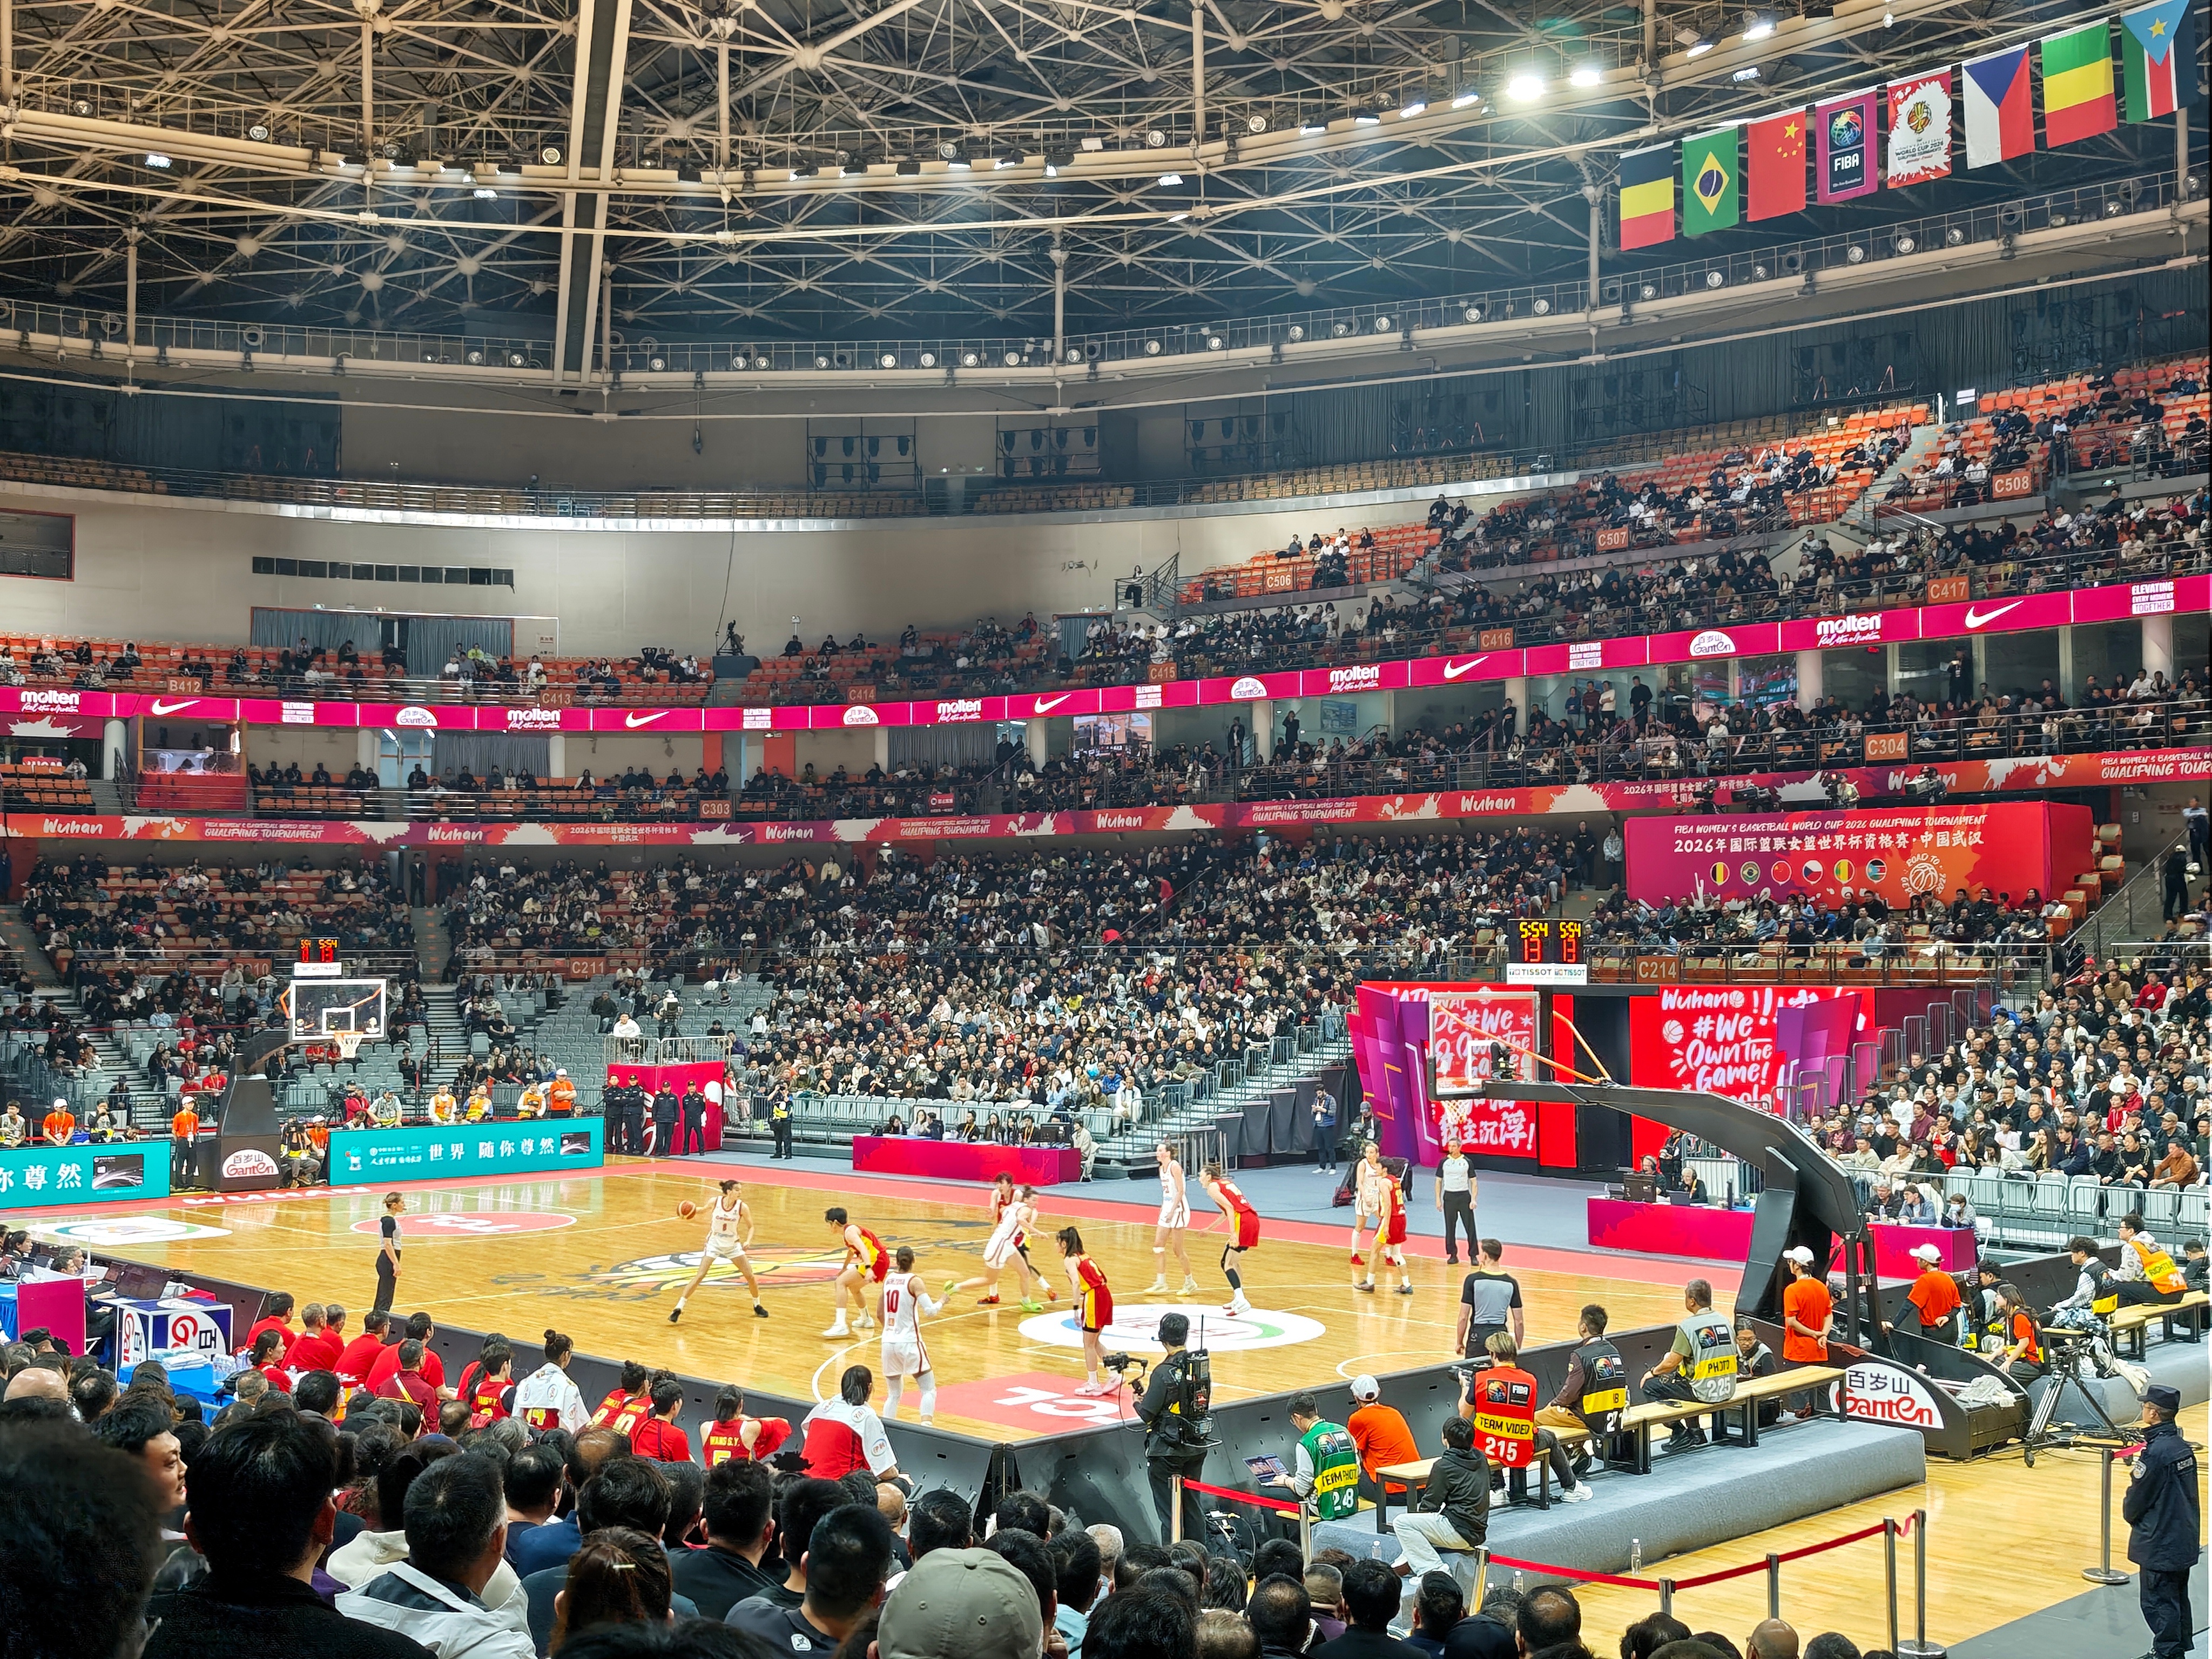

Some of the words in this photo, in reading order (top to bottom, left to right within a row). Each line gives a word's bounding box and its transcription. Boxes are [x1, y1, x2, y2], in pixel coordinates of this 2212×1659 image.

[1834, 153, 1859, 172] FIBA
[1994, 472, 2029, 494] C508
[1598, 531, 1627, 548] C507
[1266, 573, 1291, 589] C506
[2132, 581, 2174, 596] ELEVATING
[1930, 581, 1966, 601] C417
[2135, 601, 2172, 613] TOGETHER
[1816, 615, 1881, 636] molten
[1481, 632, 1511, 648] C416
[1150, 666, 1176, 680] C415
[1330, 665, 1380, 683] molten
[169, 679, 201, 693] B412
[21, 690, 80, 705] molten
[542, 692, 572, 705] C413
[848, 689, 875, 702] C414
[507, 709, 561, 721] molten
[937, 698, 982, 714] molten
[1868, 737, 1905, 756] C304
[2101, 763, 2174, 779] QUALIFYING
[702, 802, 730, 814] C303
[1461, 794, 1516, 812] Wuhan
[1096, 813, 1143, 828] Wuhan
[1253, 811, 1299, 822] QUALIFYING
[1300, 808, 1358, 820] TOURNAMENT
[1675, 825, 1694, 834] FIBA
[1696, 824, 1737, 834] WOMEN'S
[1739, 821, 1789, 833] BASKETBALL
[1792, 820, 1821, 831] WORLD
[1824, 820, 1842, 830] CUP
[1844, 819, 1867, 830] 2026
[1869, 817, 1922, 828] QUALIFYING
[1925, 814, 1988, 827] TOURNAMENT
[43, 818, 103, 836] Wuhan
[205, 828, 259, 838] QUALIFYING
[261, 830, 325, 839] TOURNAMENT
[428, 826, 483, 842] Wuhan
[765, 824, 813, 840] Wuhan
[1930, 855, 1940, 865] TO
[1520, 921, 1548, 939] 5:54
[1559, 921, 1581, 939] 5:54
[1523, 938, 1542, 963] 13
[572, 961, 605, 974] C211
[1638, 961, 1677, 979] C214
[1662, 988, 1729, 1011] Wuhan
[1462, 1007, 1514, 1033] #We
[1692, 1013, 1754, 1042] #We
[1686, 1038, 1740, 1070] Own
[1696, 1062, 1770, 1092] Game!
[428, 1142, 465, 1162] 世界
[478, 1137, 555, 1159] 随你尊然
[232, 1154, 264, 1164] 百岁山
[886, 1290, 900, 1313] 10
[1706, 1377, 1731, 1398] 225
[1848, 1370, 1910, 1397] 百岁山
[1480, 1417, 1504, 1432] TEAM
[1505, 1421, 1530, 1435] VIDEO
[1485, 1436, 1518, 1462] 215
[1321, 1471, 1343, 1489] TEAM
